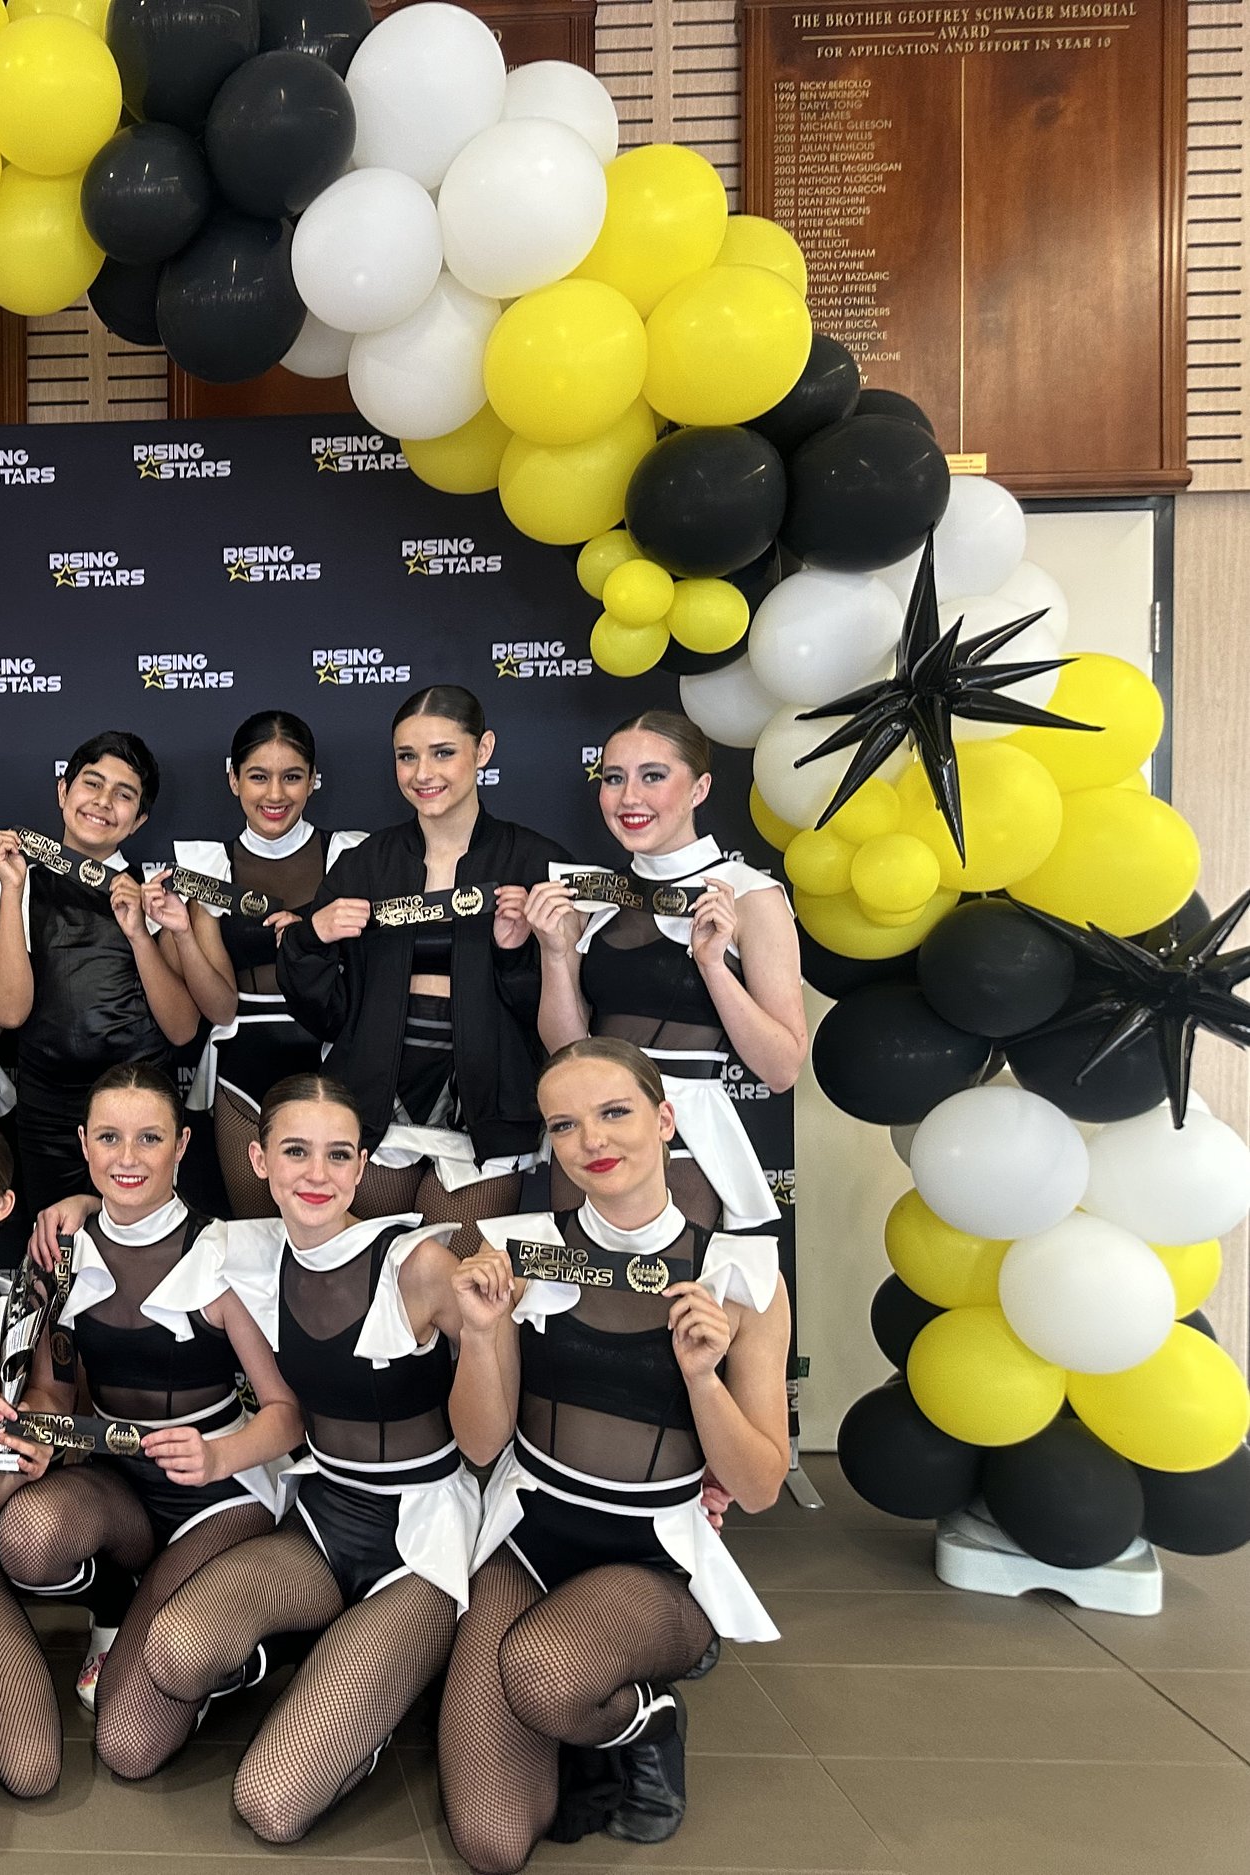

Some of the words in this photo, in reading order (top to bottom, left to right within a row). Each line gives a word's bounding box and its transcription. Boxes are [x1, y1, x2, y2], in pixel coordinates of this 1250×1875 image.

[792, 13, 820, 28] THE
[825, 10, 892, 27] BROTHER
[898, 8, 970, 24] GEOFFREY
[975, 6, 1054, 22] SCHWAGER
[1059, 2, 1137, 19] MEMORIAL
[938, 25, 990, 40] AWARD
[816, 46, 843, 58] FOR
[848, 43, 940, 57] APPLICATION
[945, 42, 975, 54] AND
[979, 39, 1030, 52] EFFORT
[1035, 38, 1051, 50] IN
[1056, 37, 1091, 49] YEAR
[1097, 36, 1111, 48] 10
[774, 82, 795, 91] 1995
[800, 81, 827, 90] NICKY
[774, 93, 796, 102] 1996
[800, 91, 817, 100] BEN
[774, 103, 795, 111] 1997
[800, 101, 830, 111] DARYL
[774, 113, 795, 122] 1998
[800, 112, 817, 121] TIM
[820, 111, 851, 120] JAMES
[774, 124, 795, 132] 1999
[800, 122, 843, 132] MICHAEL
[847, 119, 892, 130] GLEESON
[774, 134, 796, 143] 2000
[800, 132, 843, 143] MATTHEW
[774, 144, 794, 154] 2001
[800, 143, 830, 153] JULIAN
[774, 155, 796, 164] 2002
[799, 153, 827, 163] DAVID
[774, 166, 796, 175] 2003
[799, 164, 839, 174] MICHAEL
[774, 177, 796, 186] 2004
[798, 175, 842, 186] ANTHONY
[774, 188, 795, 197] 2005
[799, 186, 841, 196] RICARDO
[843, 184, 886, 194] MARCON
[774, 198, 795, 207] 2006
[798, 197, 823, 207] DEAN
[774, 208, 795, 218] 2007
[797, 207, 840, 217] MATTHEW
[842, 206, 870, 216] LYONS
[799, 218, 824, 227] PETER
[825, 216, 865, 226] GARSIDE
[799, 229, 820, 239] LIAM
[823, 228, 842, 238] BELL
[805, 250, 831, 260] ARON
[834, 248, 876, 259] CANHAM
[839, 260, 865, 270] PAINE
[840, 283, 877, 293] JEFFRIES
[844, 306, 890, 317] SAUNDERS
[845, 318, 878, 329] BUCCA
[861, 351, 901, 362] MALONE
[134, 443, 204, 461] RISING
[312, 435, 383, 454] RISING
[160, 460, 230, 479] STARS
[338, 453, 409, 472] STARS
[224, 546, 294, 564] RISING
[402, 538, 474, 557] RISING
[50, 551, 118, 570] RISING
[430, 556, 501, 575] STARS
[75, 569, 144, 587] STARS
[250, 563, 320, 582] STARS
[313, 648, 384, 667] RISING
[492, 641, 565, 660] RISING
[138, 654, 207, 672] RISING
[519, 659, 592, 678] STARS
[164, 671, 233, 689] STARS
[339, 666, 410, 685] STARS
[19, 828, 62, 855] RISING
[29, 846, 72, 874] STARS
[186, 885, 232, 908] STARS
[373, 895, 424, 916] RISING
[392, 904, 444, 926] STARS
[519, 1242, 588, 1266] RISING
[543, 1261, 613, 1287] STARS
[39, 1426, 96, 1451] STARS
